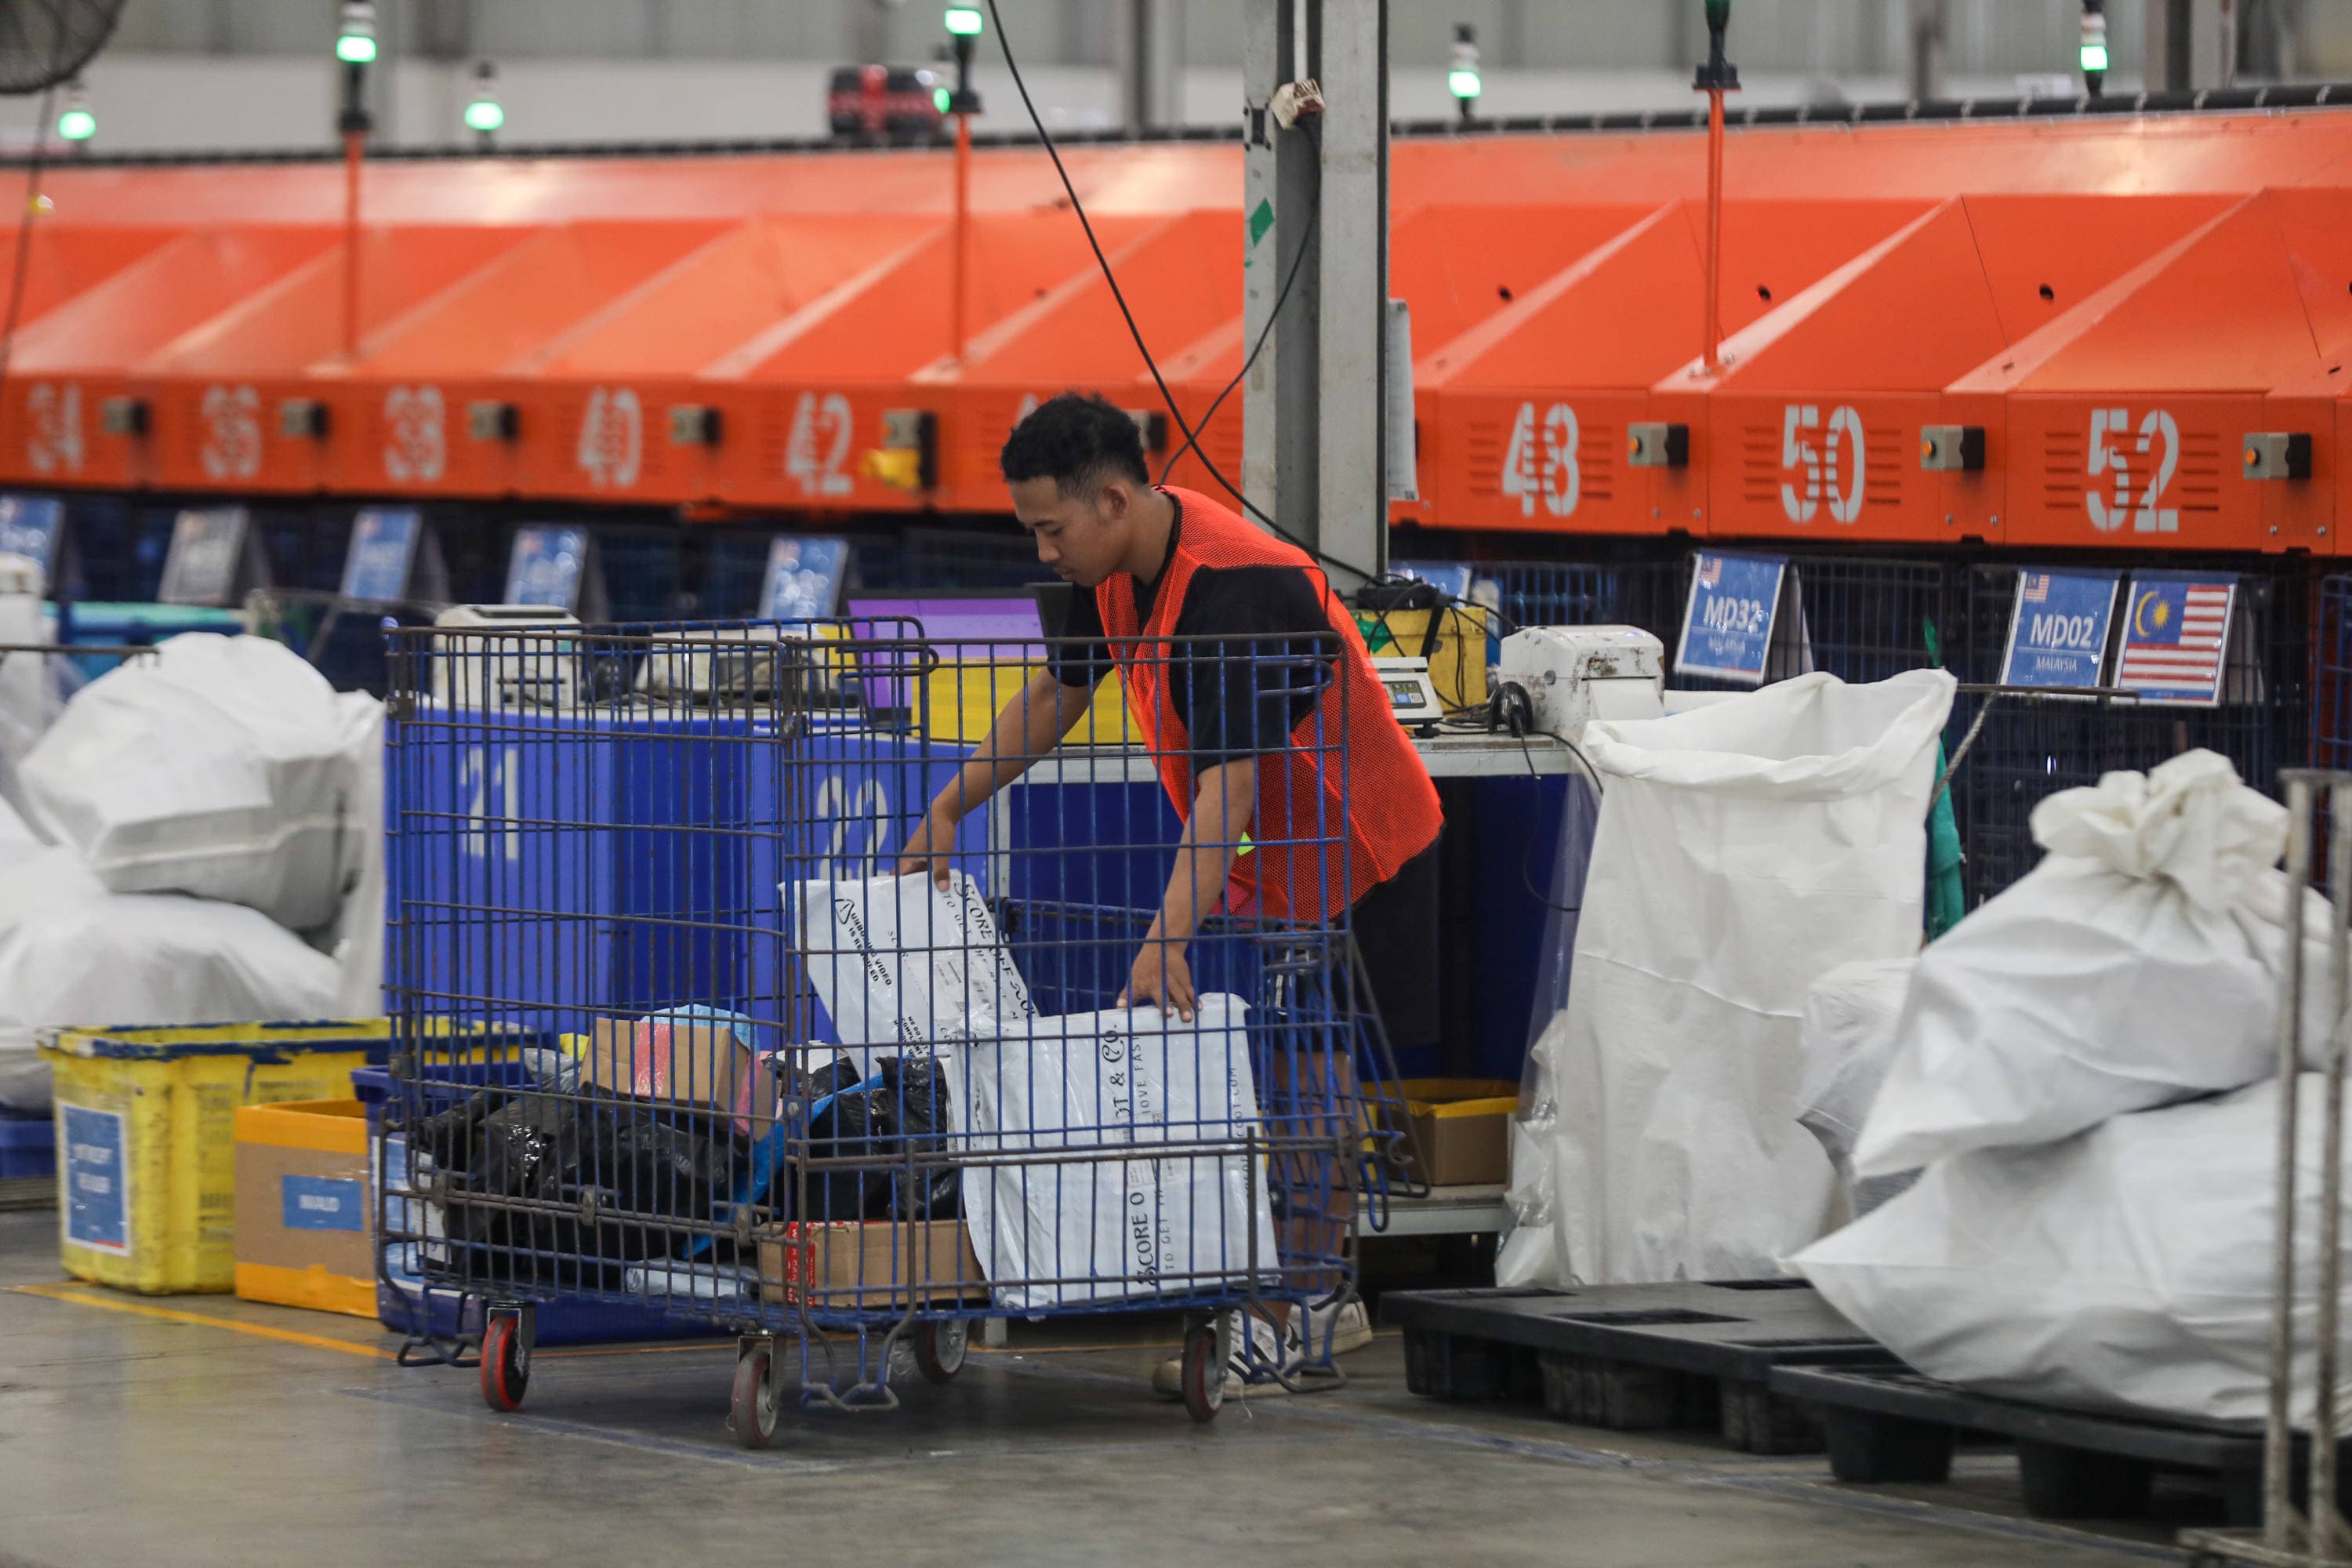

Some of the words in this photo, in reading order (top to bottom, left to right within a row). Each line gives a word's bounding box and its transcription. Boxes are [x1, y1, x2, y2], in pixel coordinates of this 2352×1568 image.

[788, 392, 854, 496] 42
[1502, 402, 1580, 517] 48
[1781, 405, 1865, 524] 50
[2086, 408, 2179, 533] 52
[1704, 594, 1762, 633] MD32
[2031, 613, 2094, 649] MD02
[2036, 655, 2077, 672] MALAYSIA
[460, 747, 518, 859] 21
[848, 927, 855, 938] IS
[874, 958, 892, 985] VIDEO
[1109, 1072, 1125, 1087] &
[1131, 1213, 1157, 1286] SCORE
[1164, 1252, 1175, 1272] TO
